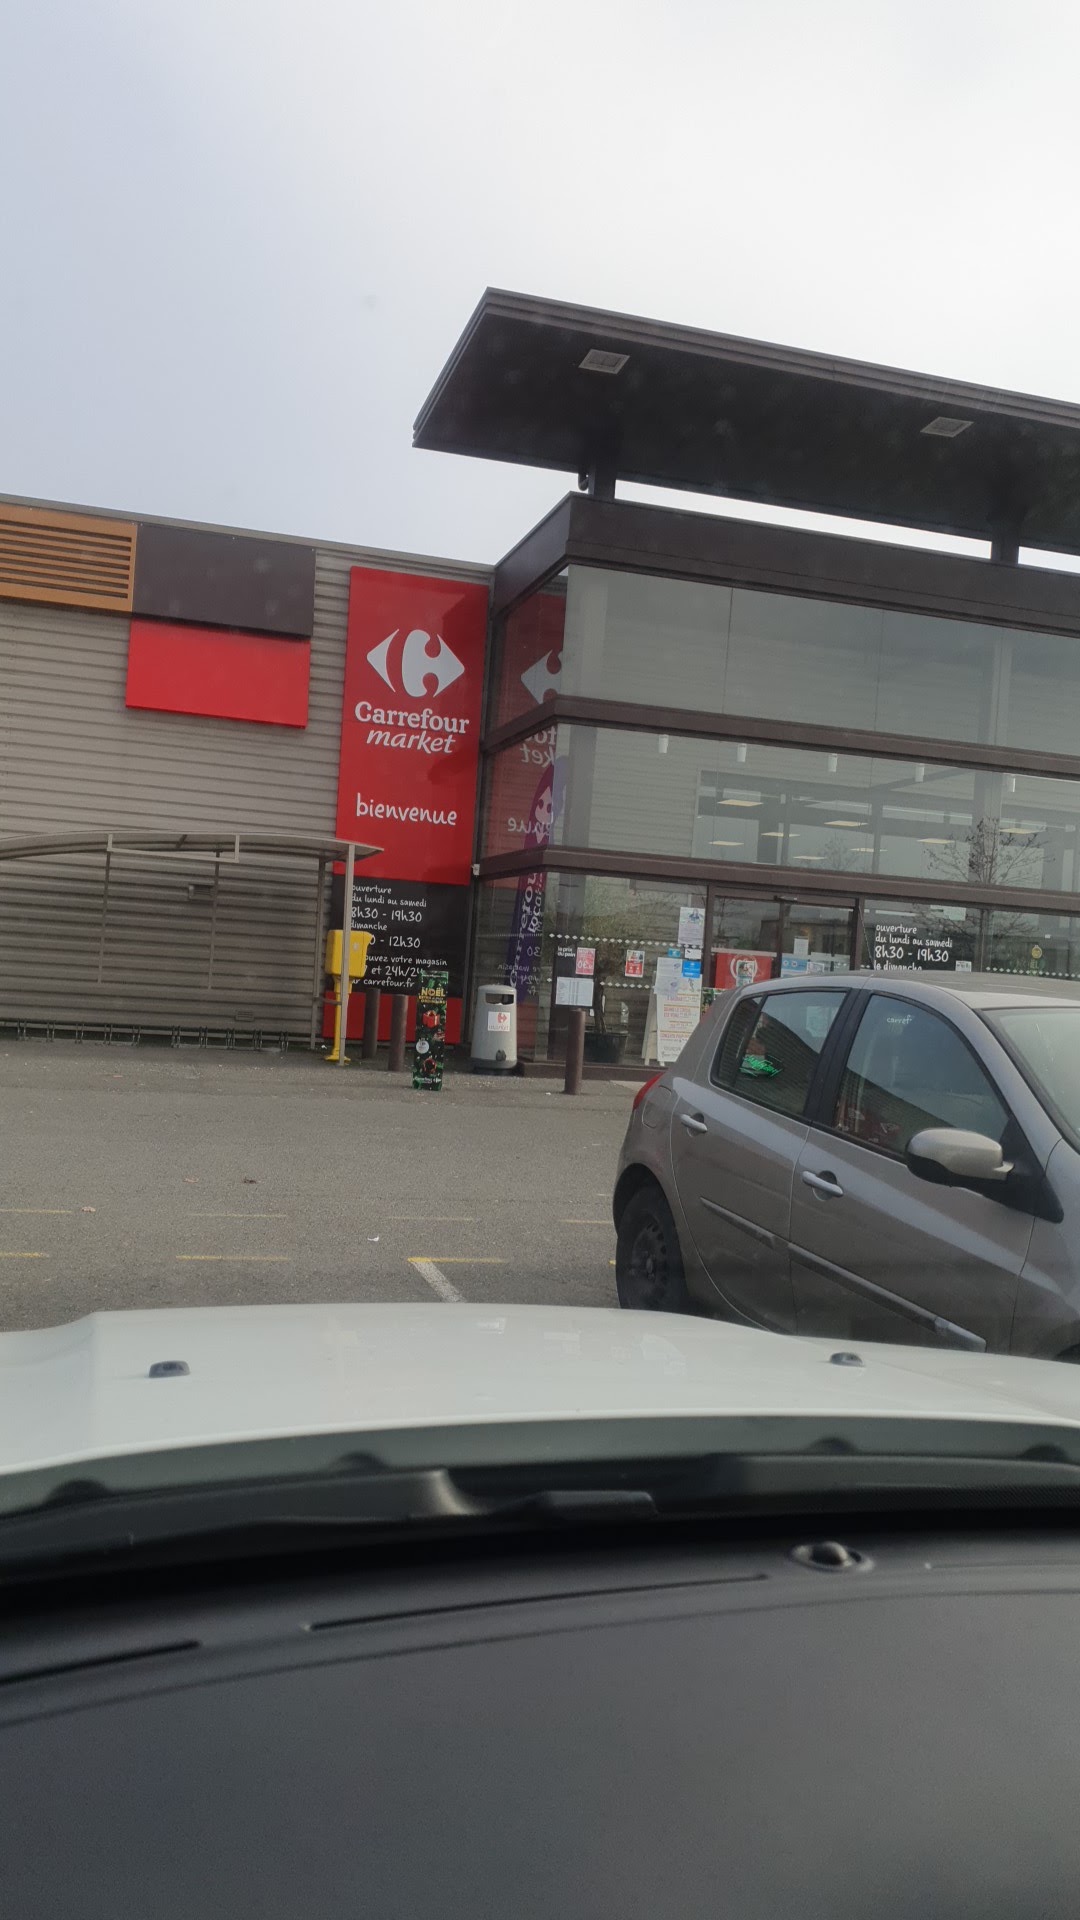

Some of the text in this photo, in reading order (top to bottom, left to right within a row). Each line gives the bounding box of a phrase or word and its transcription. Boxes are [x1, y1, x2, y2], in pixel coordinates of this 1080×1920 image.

[354, 701, 470, 734] Carrefour
[366, 729, 456, 754] market
[356, 792, 457, 825] bienvenue
[352, 884, 392, 894] ouverture
[351, 893, 427, 908] du lundi au samedi
[351, 907, 378, 919] 8h30
[391, 910, 422, 922] 19h30
[876, 924, 917, 934] ouverture
[389, 936, 420, 948] 12h30
[875, 932, 886, 942] du
[889, 933, 910, 944] lundi
[925, 937, 953, 948] samedi
[875, 945, 904, 959] 8h30
[917, 948, 949, 962] 19h30
[391, 955, 413, 964] votre
[415, 958, 447, 968] magasin
[371, 966, 382, 975] et
[363, 977, 415, 988] carrefour.fr
[421, 986, 446, 997] NOËL
